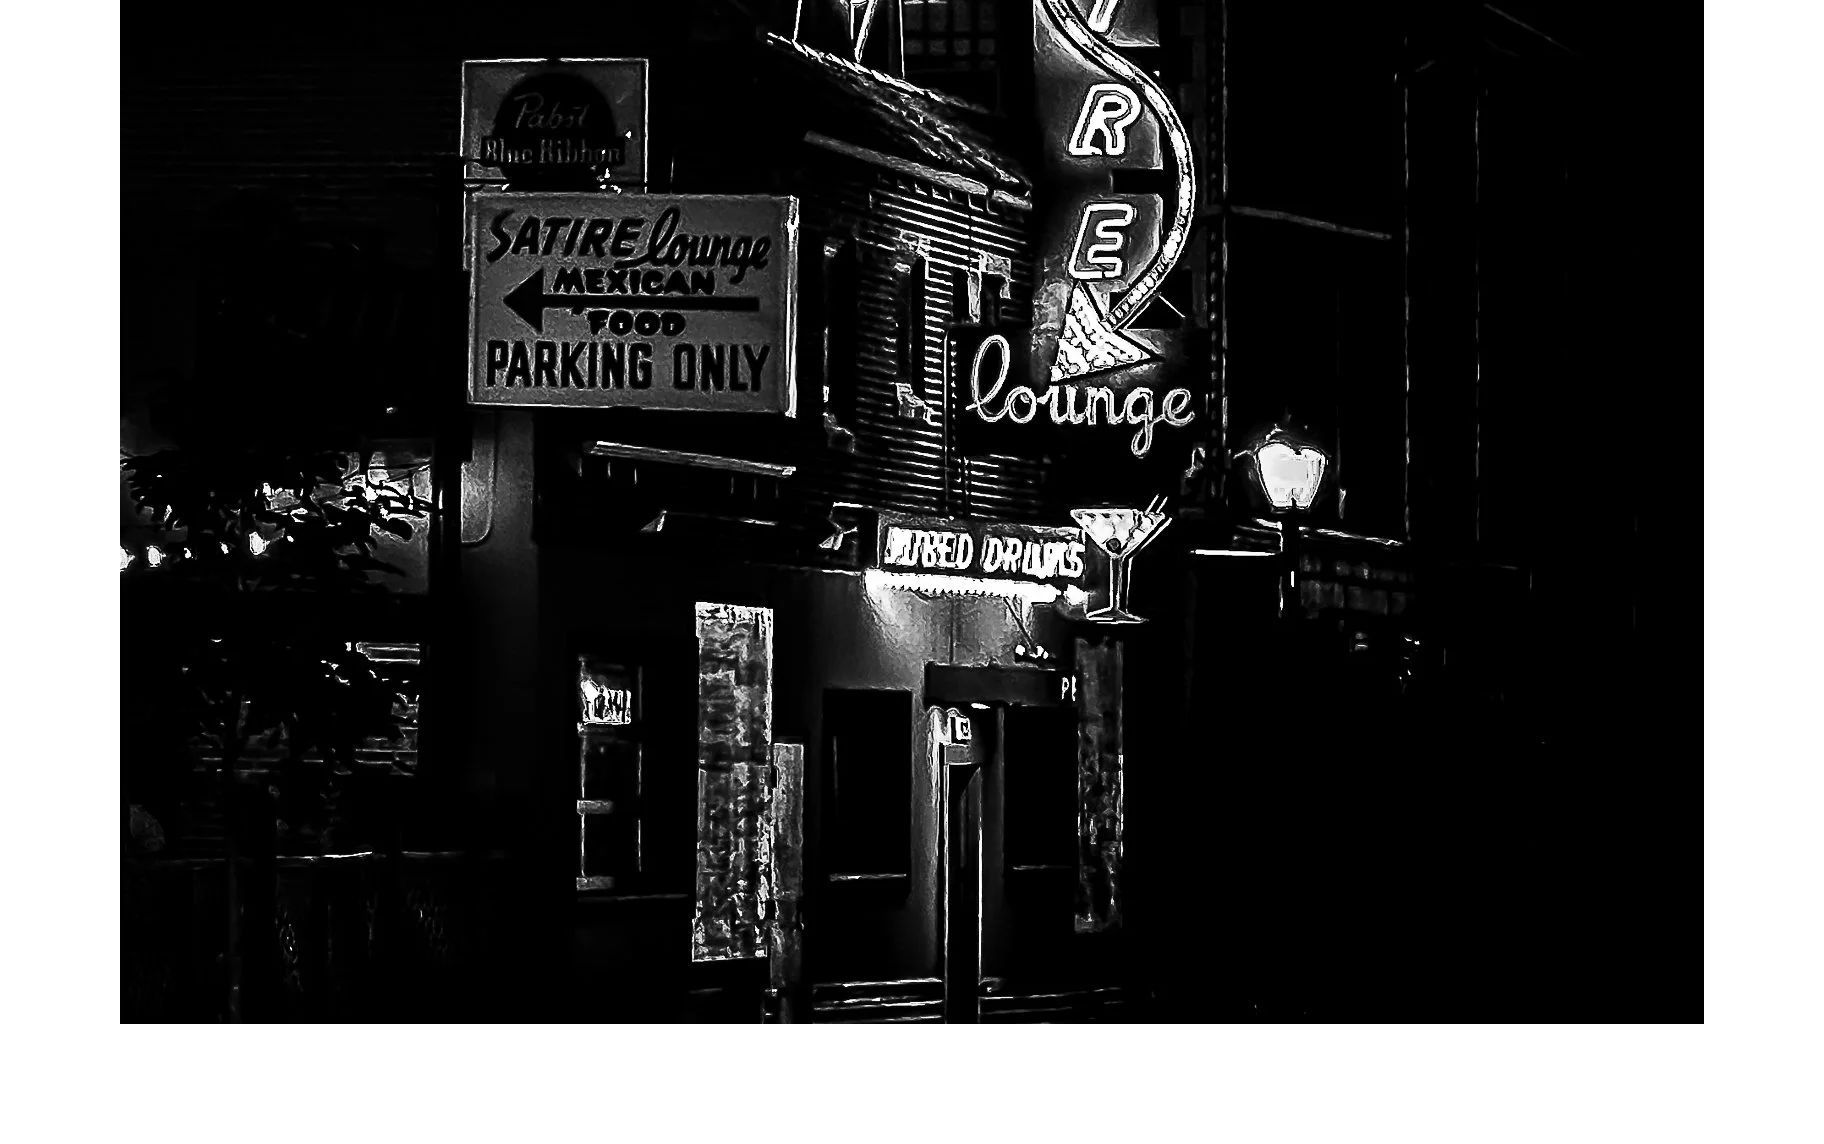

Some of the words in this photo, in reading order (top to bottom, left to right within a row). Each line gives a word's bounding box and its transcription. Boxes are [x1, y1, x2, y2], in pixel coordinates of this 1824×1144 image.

[513, 91, 590, 130] Pabst
[484, 137, 534, 165] Blue
[538, 137, 622, 165] Ribbon
[486, 209, 645, 262] SATIRE
[614, 206, 771, 284] lounge
[552, 268, 715, 295] MEXICAN
[586, 310, 686, 336] FOOD
[486, 340, 653, 388] PARKING
[673, 342, 770, 391] ONLY
[965, 334, 1196, 458] lounge
